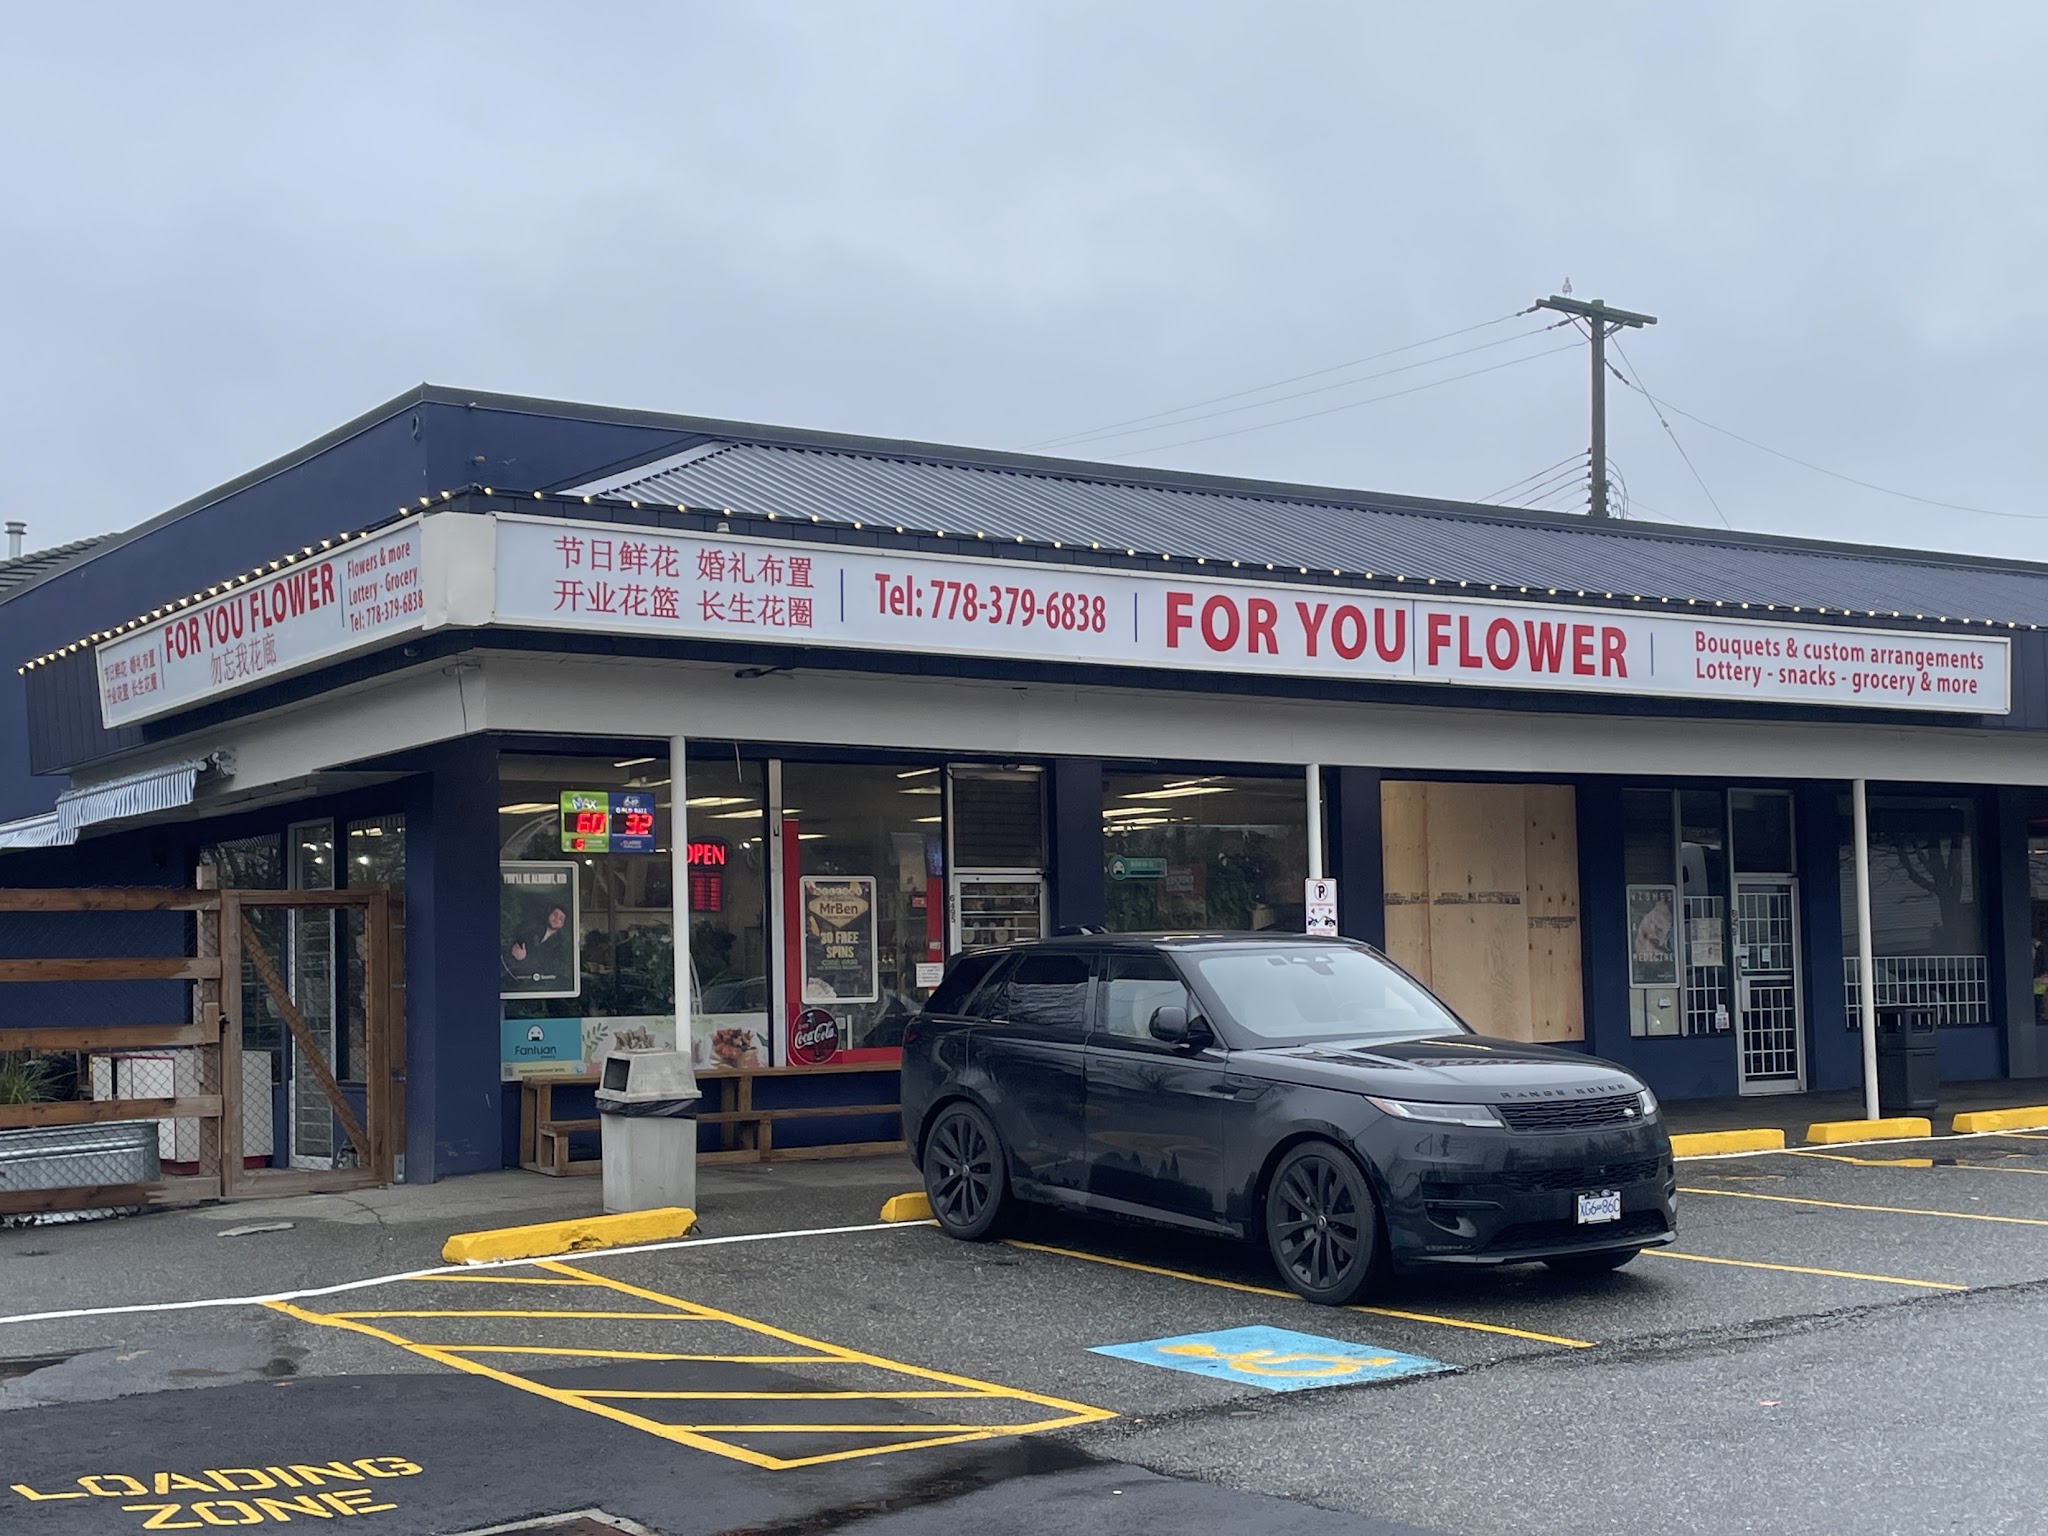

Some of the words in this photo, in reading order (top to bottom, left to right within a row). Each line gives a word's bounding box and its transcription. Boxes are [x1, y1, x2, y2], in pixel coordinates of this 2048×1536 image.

[347, 554, 378, 580] Flowers
[380, 546, 386, 567] &
[388, 541, 411, 563] more
[553, 535, 680, 577] 节日鲜花
[696, 548, 814, 588] 婚礼布置
[348, 581, 378, 606] Lottery
[385, 567, 418, 592] Grocery
[553, 579, 680, 619] 开业花篮
[696, 589, 813, 629] 长生花圈
[875, 574, 922, 618] Tel:
[930, 579, 1107, 634] 778-379-6838
[165, 616, 201, 664] FOR
[204, 598, 244, 648] YOU
[250, 562, 335, 633] FLOWER
[350, 610, 365, 632] Tel:
[366, 589, 423, 627] 778-379-6838
[1165, 591, 1279, 655] FOR
[1295, 601, 1406, 663] YOU
[1428, 612, 1629, 678] FLOWER
[1695, 630, 1780, 660] Bouquets
[1786, 639, 1798, 658] &
[1803, 641, 1865, 663] custom
[1870, 647, 1984, 673] arrangements
[210, 632, 277, 686] 勿忘我花廊
[1696, 658, 1762, 688] Lottery
[1778, 664, 1836, 687] snacks
[1852, 671, 1915, 696] grocery
[1921, 674, 1931, 692] &
[1936, 677, 1977, 694] more
[571, 796, 598, 810] MAX
[576, 812, 606, 834] 60
[625, 813, 653, 835] 32
[820, 903, 858, 915] MrBen
[820, 931, 834, 944] 30
[835, 931, 859, 944] FREE
[826, 945, 854, 959] SPINS
[1632, 952, 1673, 962] MEDICINE
[514, 1045, 557, 1056] Fantuan
[1500, 1089, 1566, 1099] RANGE
[1575, 1083, 1626, 1095] ROVER
[10, 1457, 424, 1501] LOADING
[121, 1488, 398, 1530] ZONE
